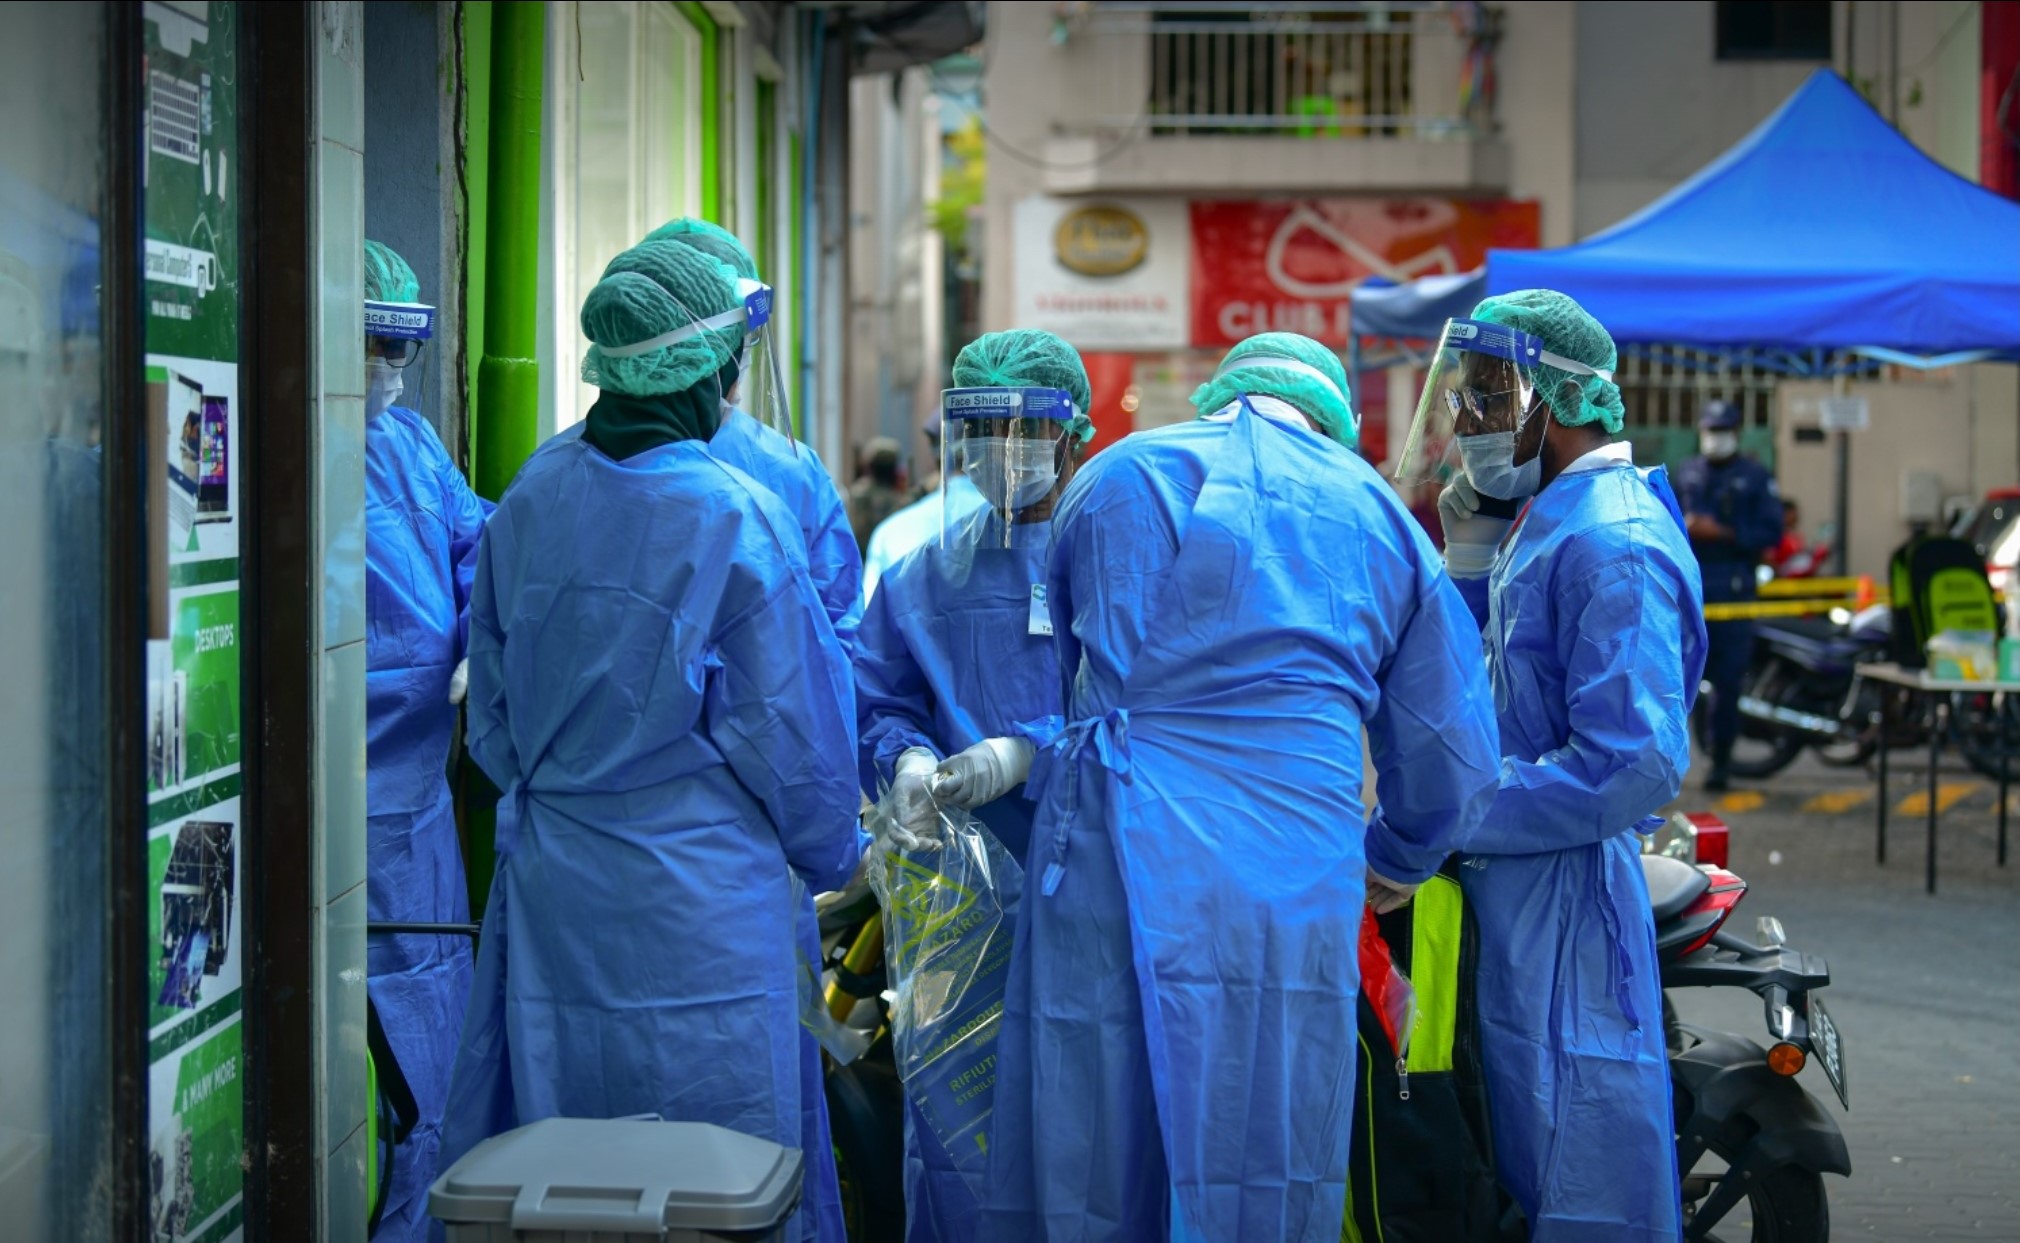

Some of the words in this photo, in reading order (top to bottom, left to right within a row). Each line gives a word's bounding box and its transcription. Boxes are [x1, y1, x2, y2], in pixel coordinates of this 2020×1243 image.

[364, 312, 386, 323] ace
[389, 314, 422, 326] Shield
[1218, 300, 1327, 339] CLUB
[950, 396, 971, 407] Face
[974, 395, 1011, 406] Shield
[195, 623, 234, 652] DESKTOPS
[189, 1075, 214, 1109] MANY
[214, 1056, 237, 1091] MORE
